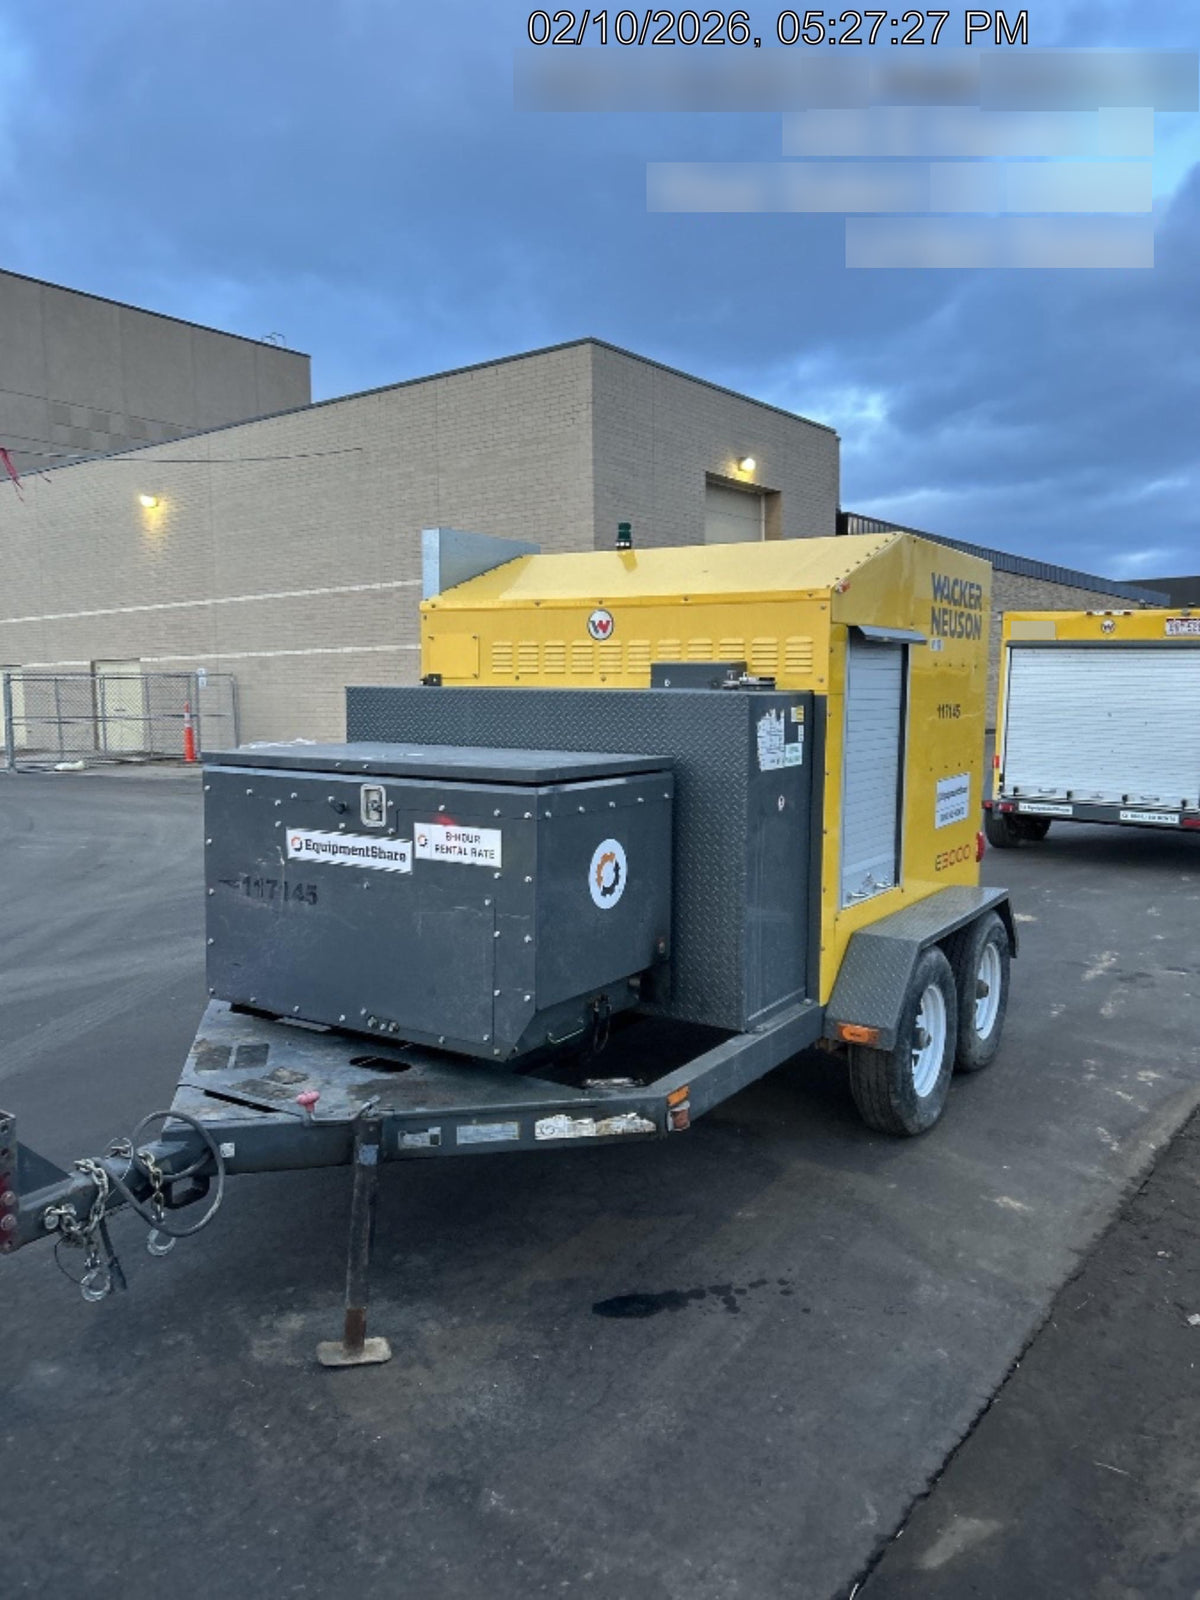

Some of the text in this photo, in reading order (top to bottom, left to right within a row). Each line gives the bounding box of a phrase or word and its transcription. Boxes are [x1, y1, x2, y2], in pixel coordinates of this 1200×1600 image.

[931, 572, 982, 612] WACKER
[931, 606, 982, 640] NEUSON
[304, 839, 406, 863] EquipmentShare
[435, 844, 495, 859] RENTAL RATE
